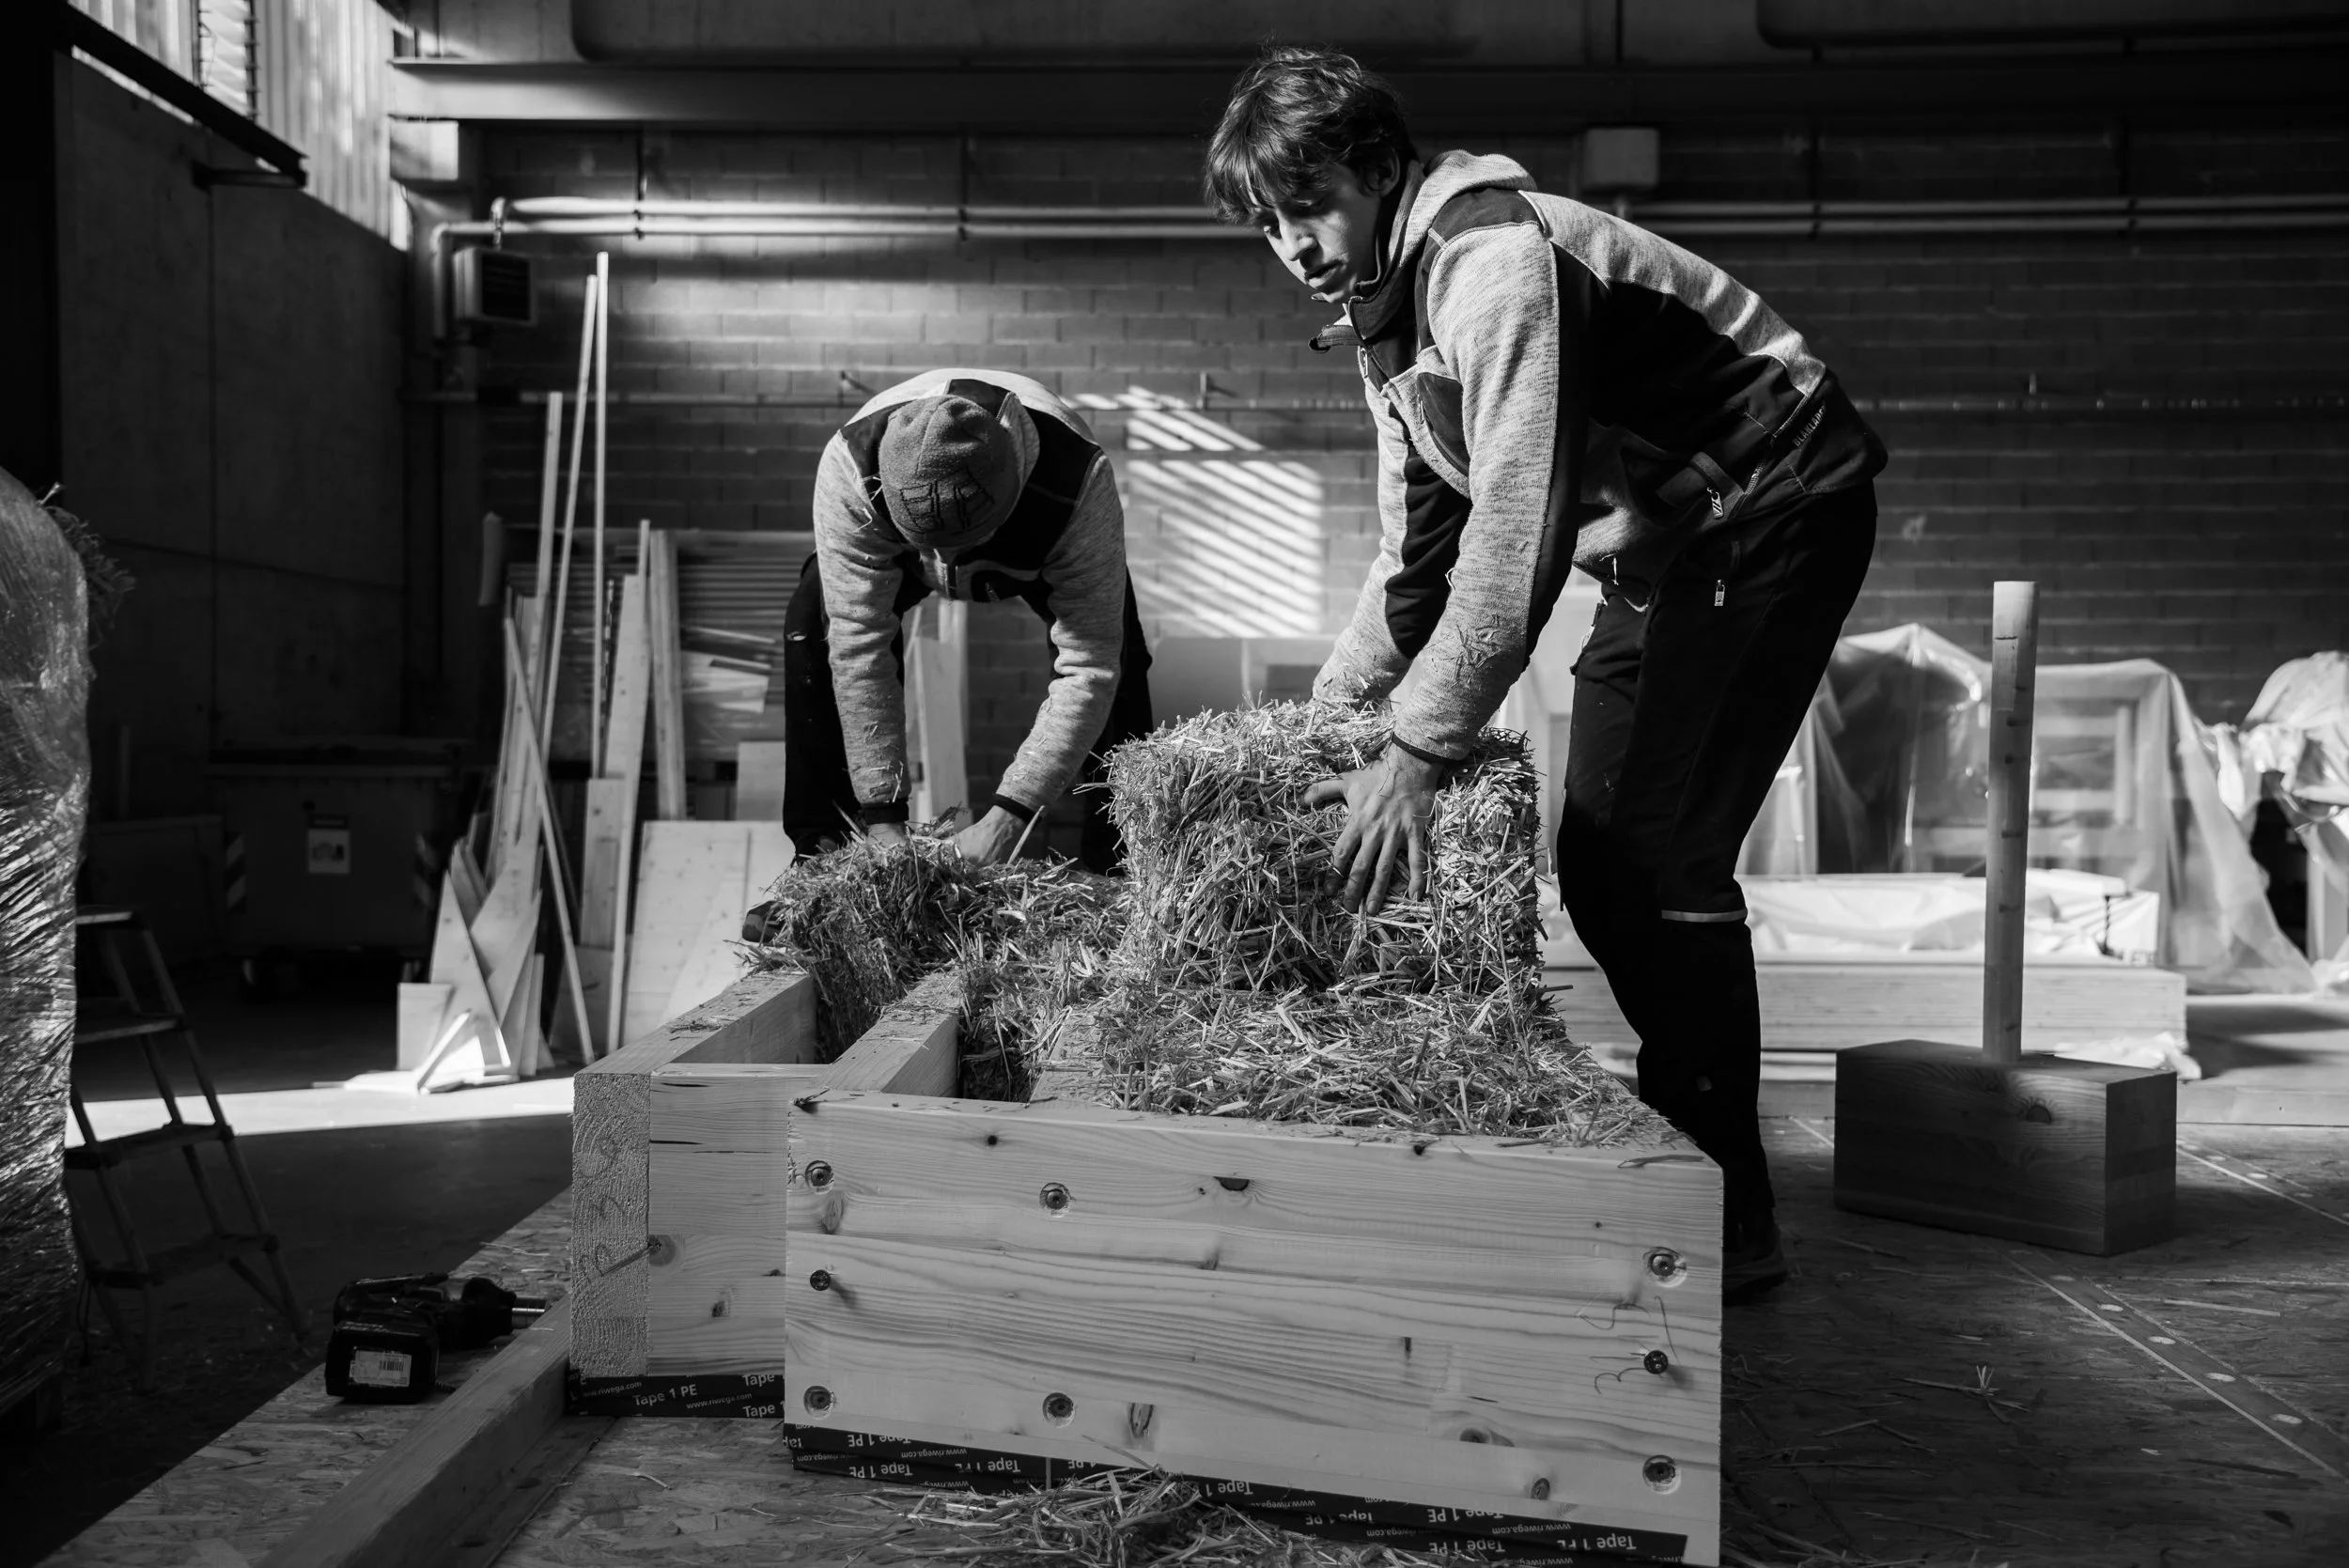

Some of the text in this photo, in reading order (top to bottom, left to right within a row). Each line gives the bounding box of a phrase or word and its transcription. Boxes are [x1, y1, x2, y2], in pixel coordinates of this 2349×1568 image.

[742, 1374, 775, 1387] Tape
[631, 1384, 698, 1406] Tape 1 PE
[686, 1393, 753, 1409] www.riwega.com
[742, 1404, 775, 1418] Tape
[848, 1434, 863, 1447] PE
[868, 1434, 875, 1446] 1
[901, 1448, 967, 1458] www.riwega.com
[848, 1462, 913, 1479] Tape 1 PE
[988, 1457, 1021, 1473] Tape
[1206, 1481, 1253, 1497] Tape 1
[1303, 1514, 1323, 1526] PE
[1426, 1509, 1447, 1522] PE
[1452, 1508, 1460, 1522] 1
[1492, 1523, 1571, 1534] www.riwega.com
[1467, 1538, 1505, 1553] Tape
[1583, 1538, 1591, 1551] 1
[1596, 1533, 1637, 1551] Tape
[1429, 1542, 1448, 1557] PE
